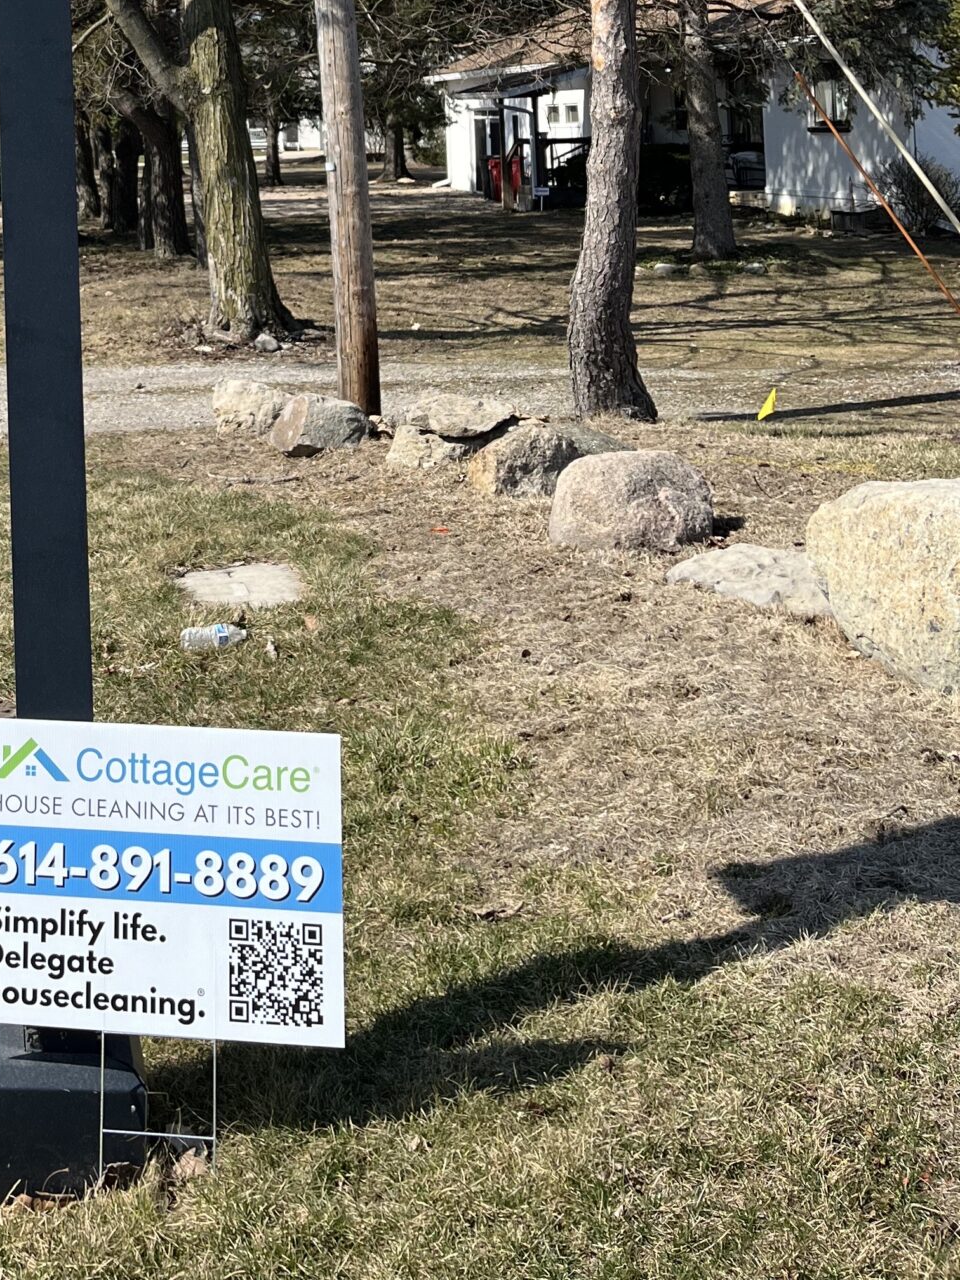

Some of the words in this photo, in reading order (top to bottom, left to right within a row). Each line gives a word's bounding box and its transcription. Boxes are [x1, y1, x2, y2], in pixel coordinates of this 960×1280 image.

[76, 747, 311, 796] CottageCare
[71, 797, 185, 822] CLEANING
[194, 803, 219, 824] AT
[228, 805, 256, 826] ITS
[265, 807, 321, 830] BEST!
[113, 912, 167, 943] life.
